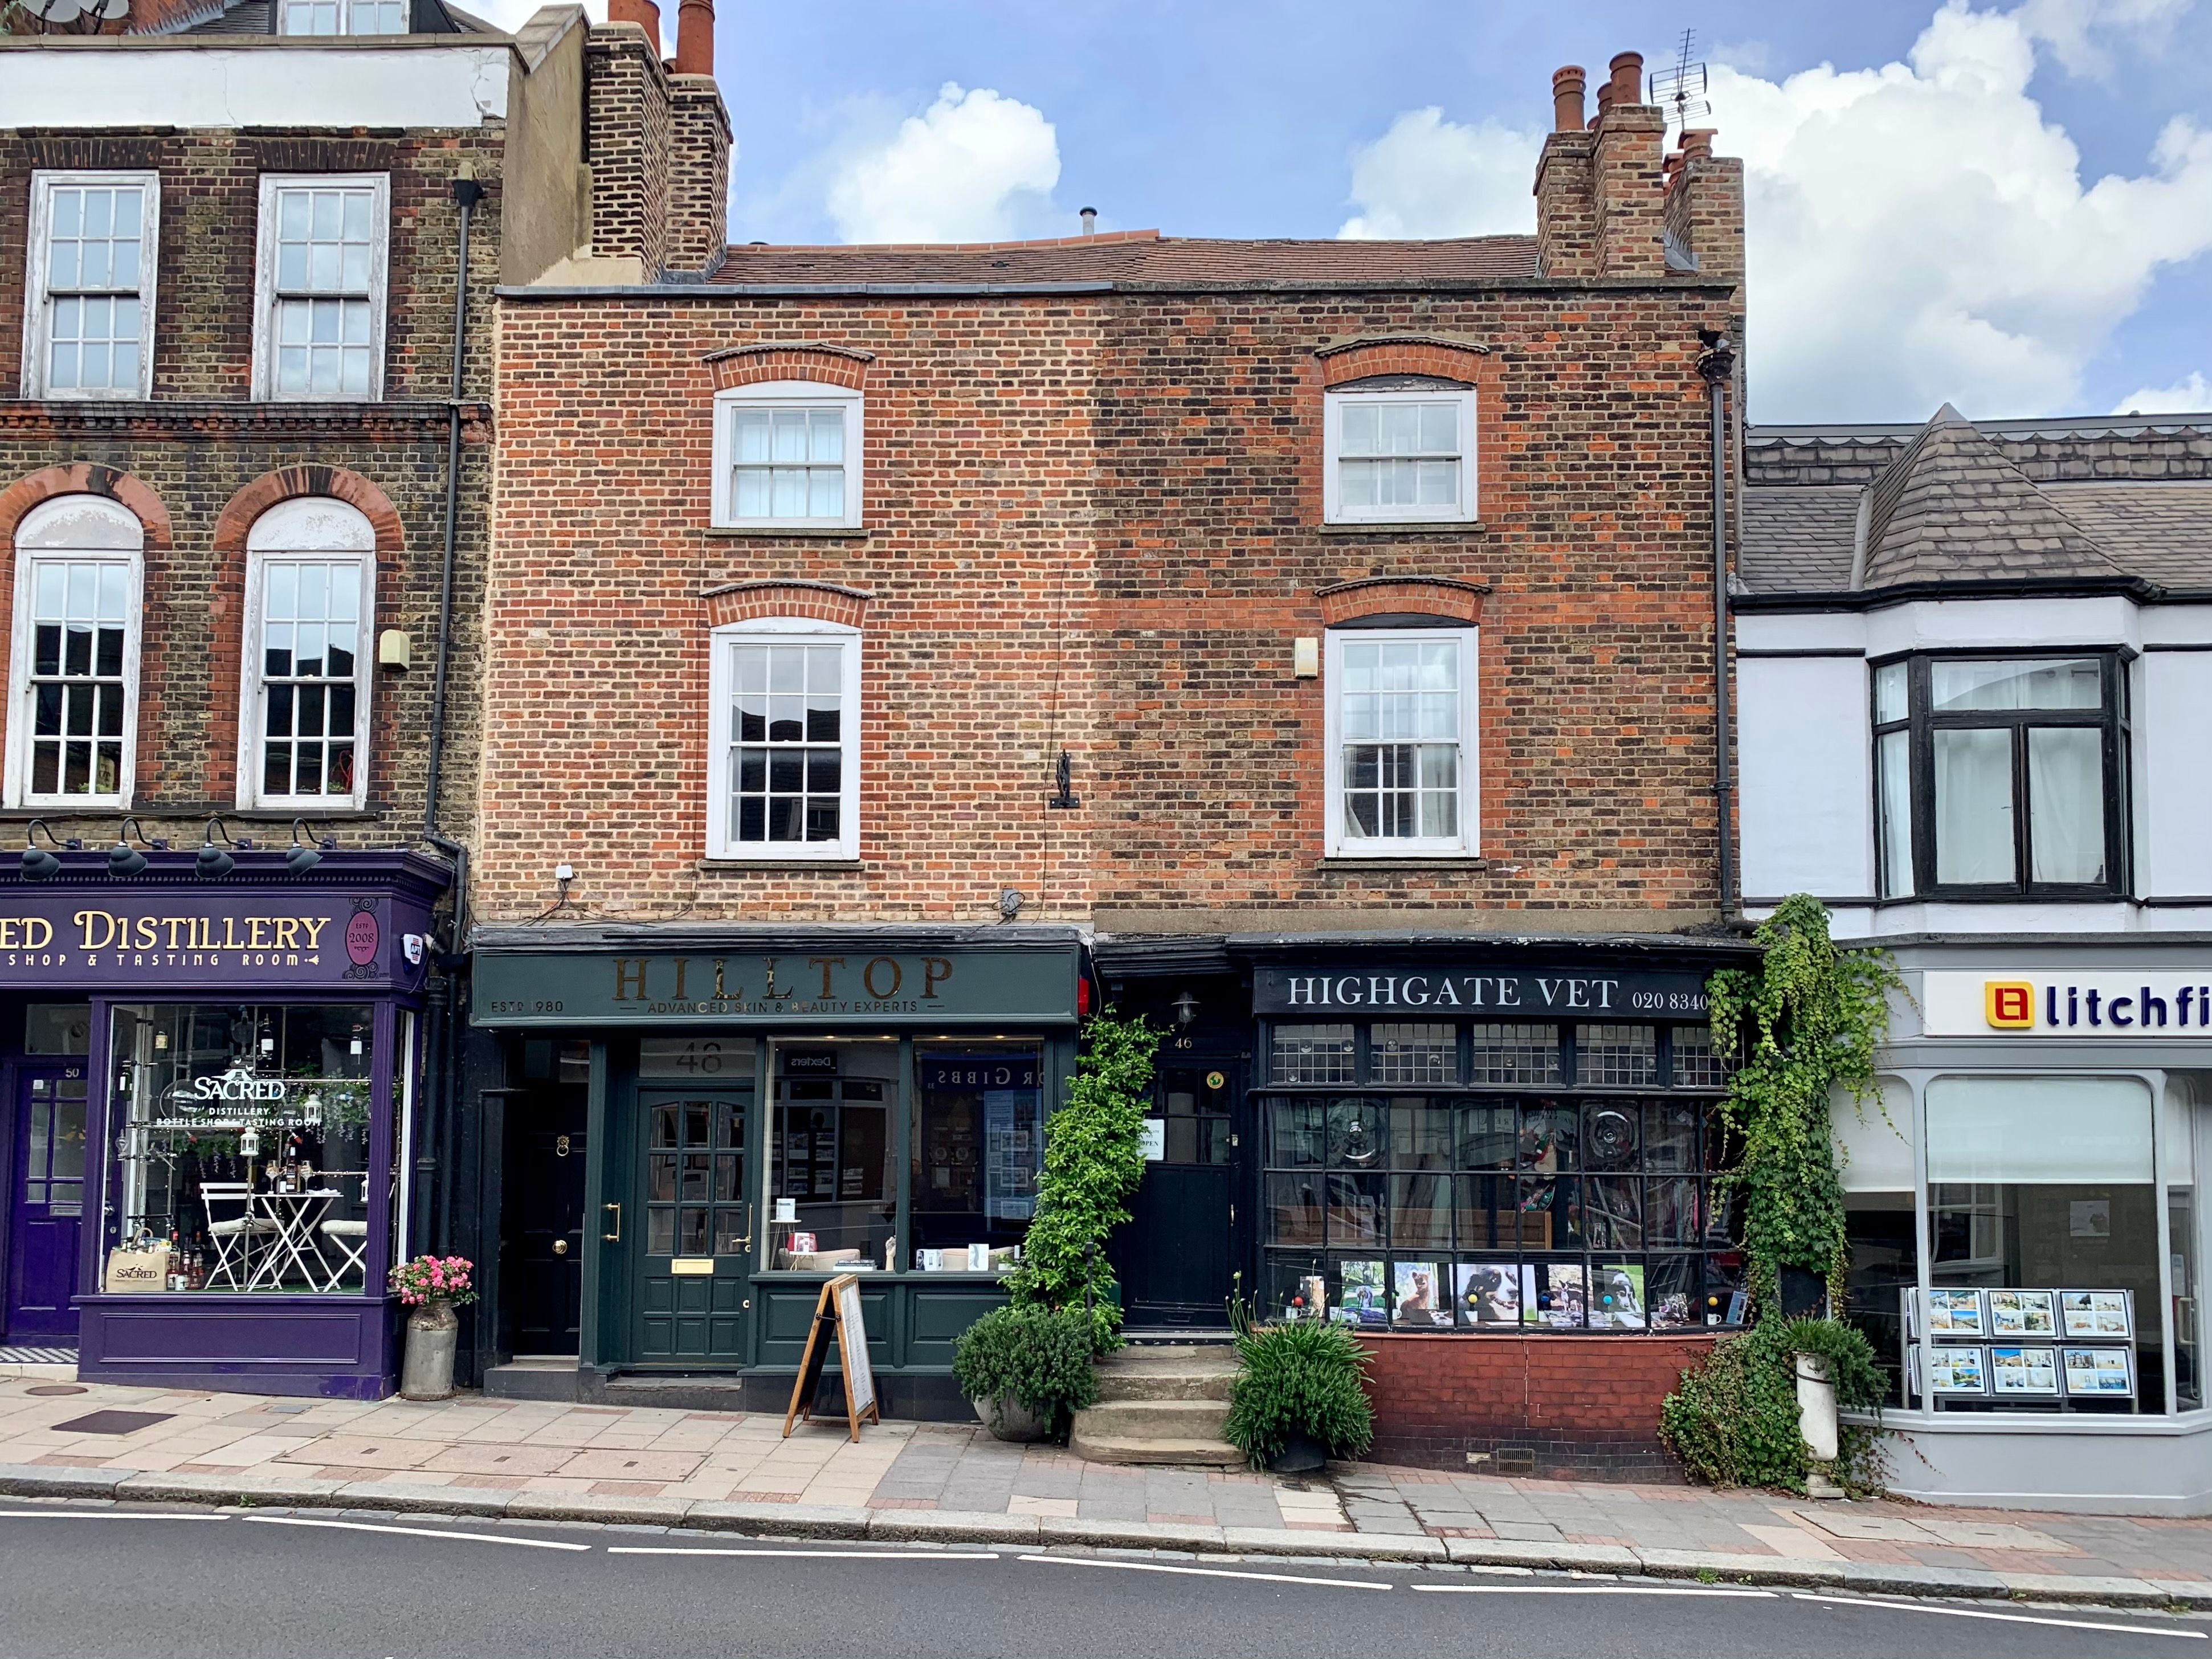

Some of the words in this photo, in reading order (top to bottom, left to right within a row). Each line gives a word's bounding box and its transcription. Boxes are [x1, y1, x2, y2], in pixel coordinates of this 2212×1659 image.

[349, 933, 374, 943] 2008
[9, 954, 66, 966] SHOP
[88, 954, 97, 966] &
[117, 954, 218, 966] TASTING
[242, 954, 298, 966] ROOM
[611, 956, 953, 1000] HILLTOP
[1287, 976, 1521, 1006] HIGHGATE
[1535, 978, 1619, 1008] VET
[1633, 992, 1664, 1009] 020
[1669, 993, 1708, 1010] 8340
[530, 1001, 564, 1012] 1980
[647, 1002, 728, 1014] ADVANCED
[734, 1002, 768, 1013] SKIN
[774, 1001, 784, 1012] &
[791, 1001, 848, 1013] BEAUTY
[854, 1001, 917, 1012] EXPERTS
[2047, 986, 2210, 1027] litchfi
[1174, 1037, 1192, 1049] 46
[676, 1041, 722, 1074] 48
[65, 1068, 79, 1078] 50
[194, 1077, 285, 1100] SACRED
[209, 1107, 270, 1115] DISTILLERY
[116, 1269, 157, 1278] SACRED
